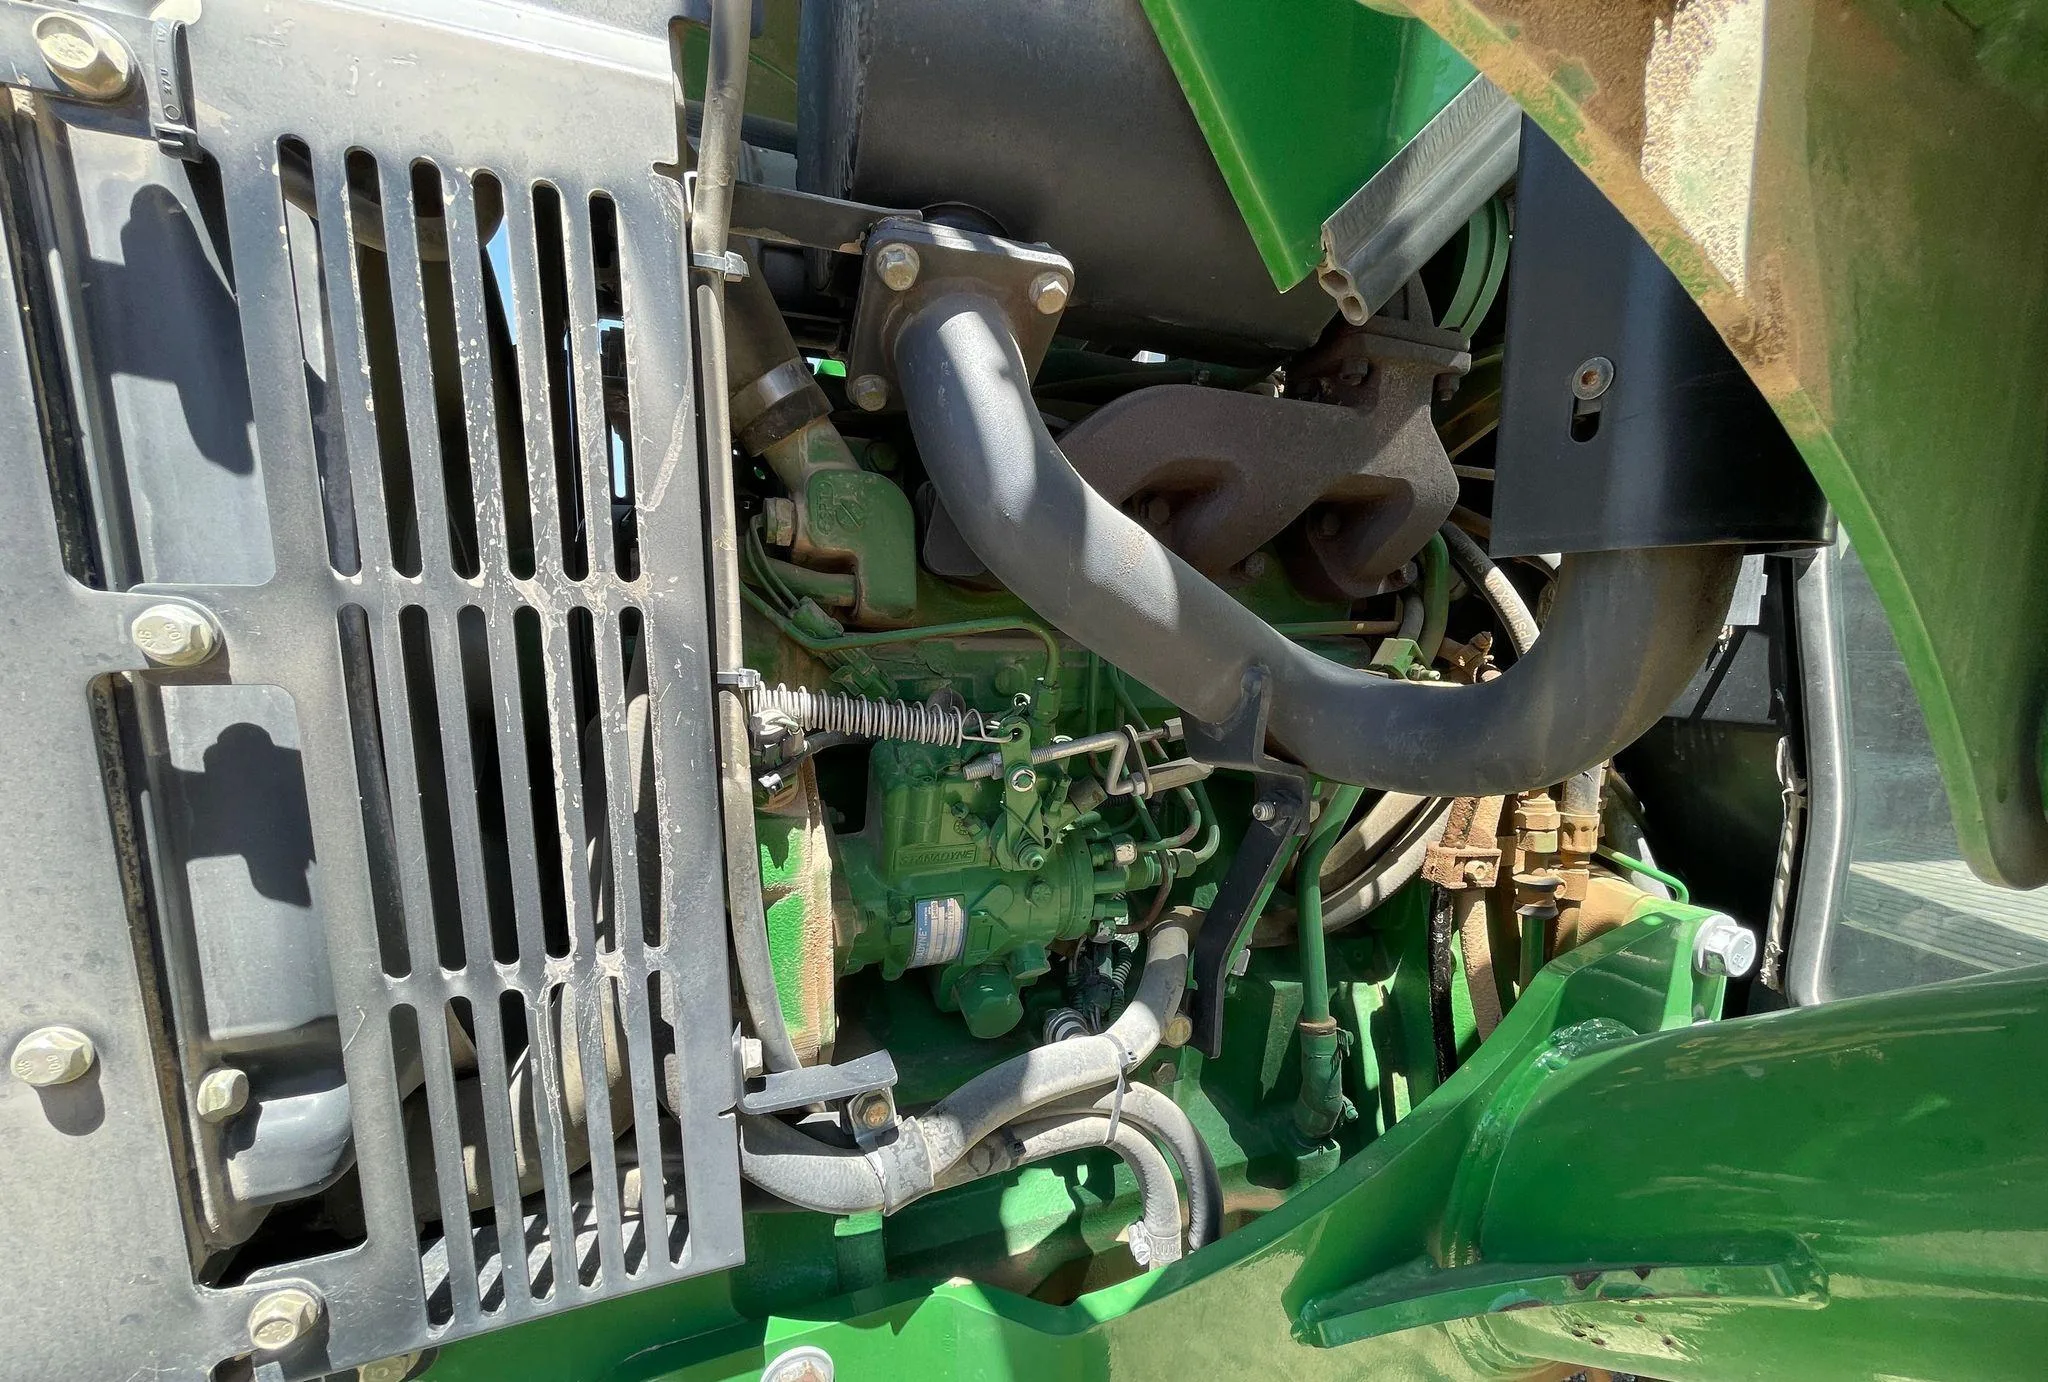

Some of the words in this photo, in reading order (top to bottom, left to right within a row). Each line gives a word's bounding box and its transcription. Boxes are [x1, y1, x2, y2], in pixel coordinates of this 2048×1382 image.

[1497, 591, 1520, 619] MAX
[1515, 619, 1532, 640] PSI
[899, 849, 974, 865] STANADYNE
